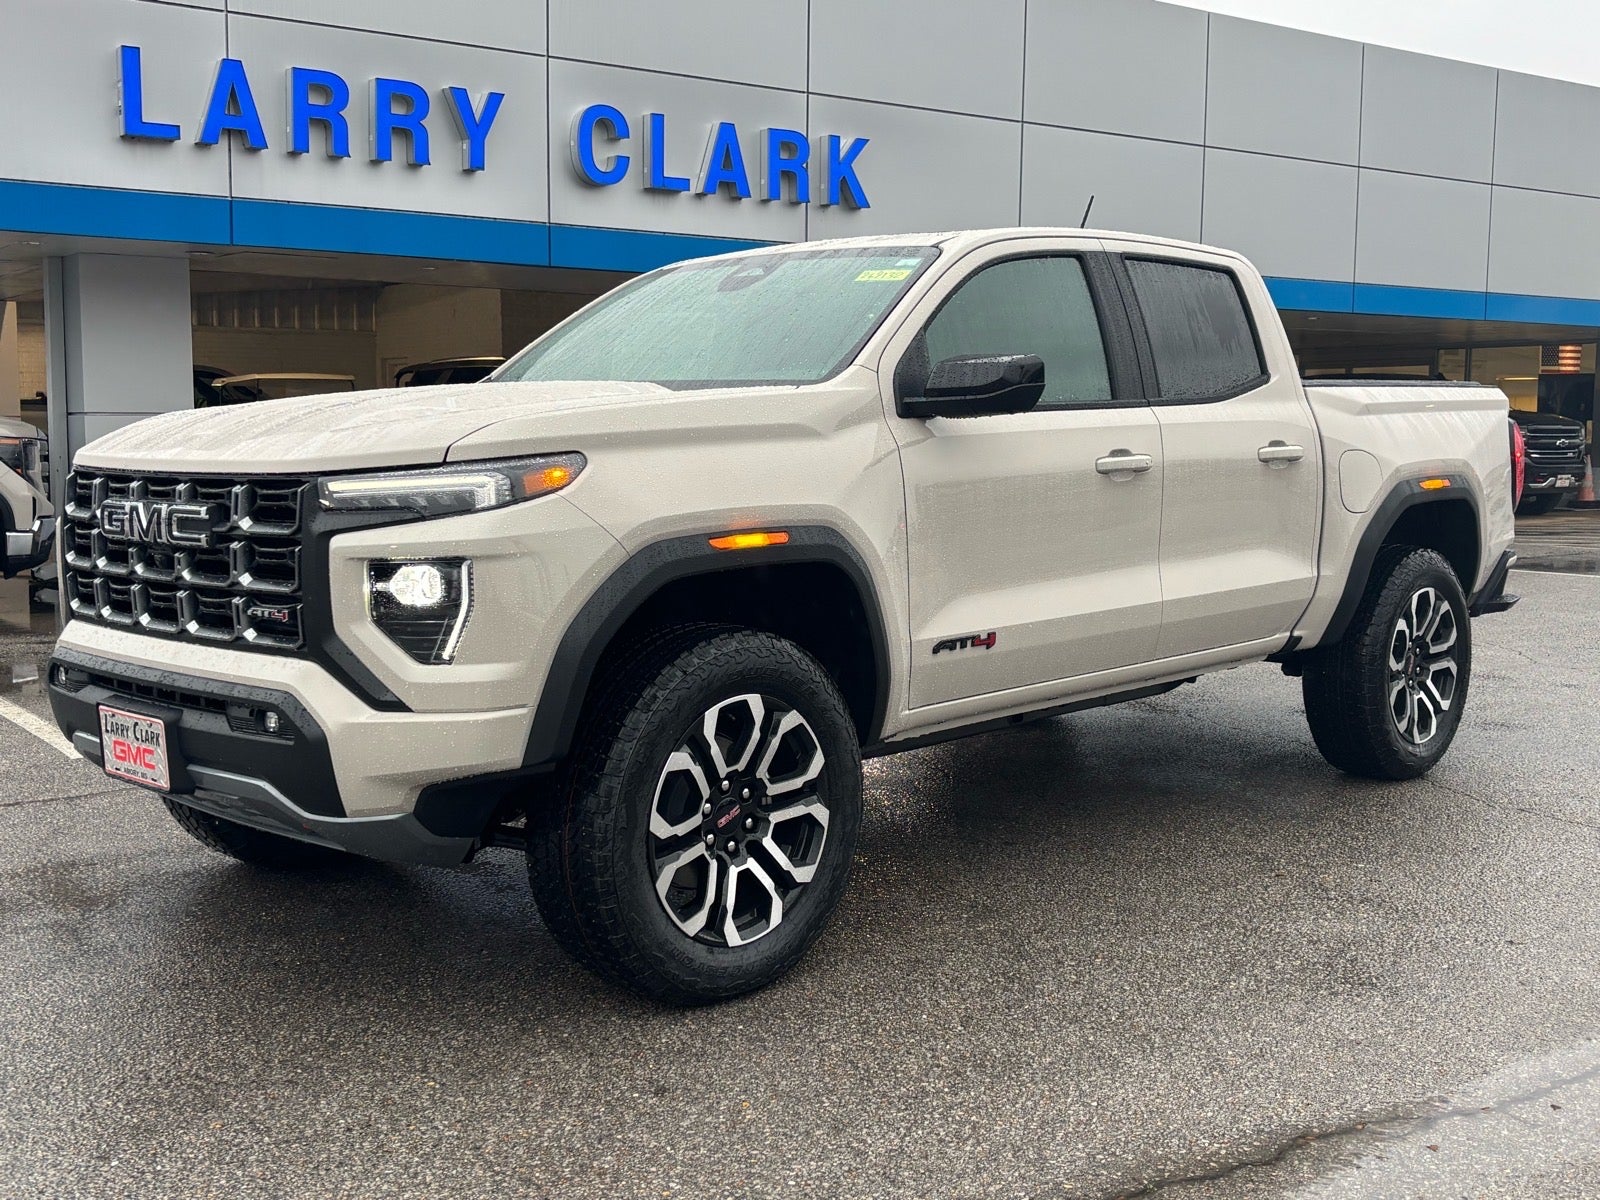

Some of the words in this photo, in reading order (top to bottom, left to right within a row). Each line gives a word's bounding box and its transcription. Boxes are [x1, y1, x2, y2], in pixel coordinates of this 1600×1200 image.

[117, 45, 504, 171] LARRY
[571, 104, 869, 210] CLARK
[100, 500, 209, 547] GMC
[247, 607, 289, 622] AT4
[932, 632, 997, 654] AT4
[104, 713, 130, 739] LARRY
[133, 721, 161, 747] CLARK
[113, 739, 156, 770] GMC
[716, 804, 741, 828] GMC
